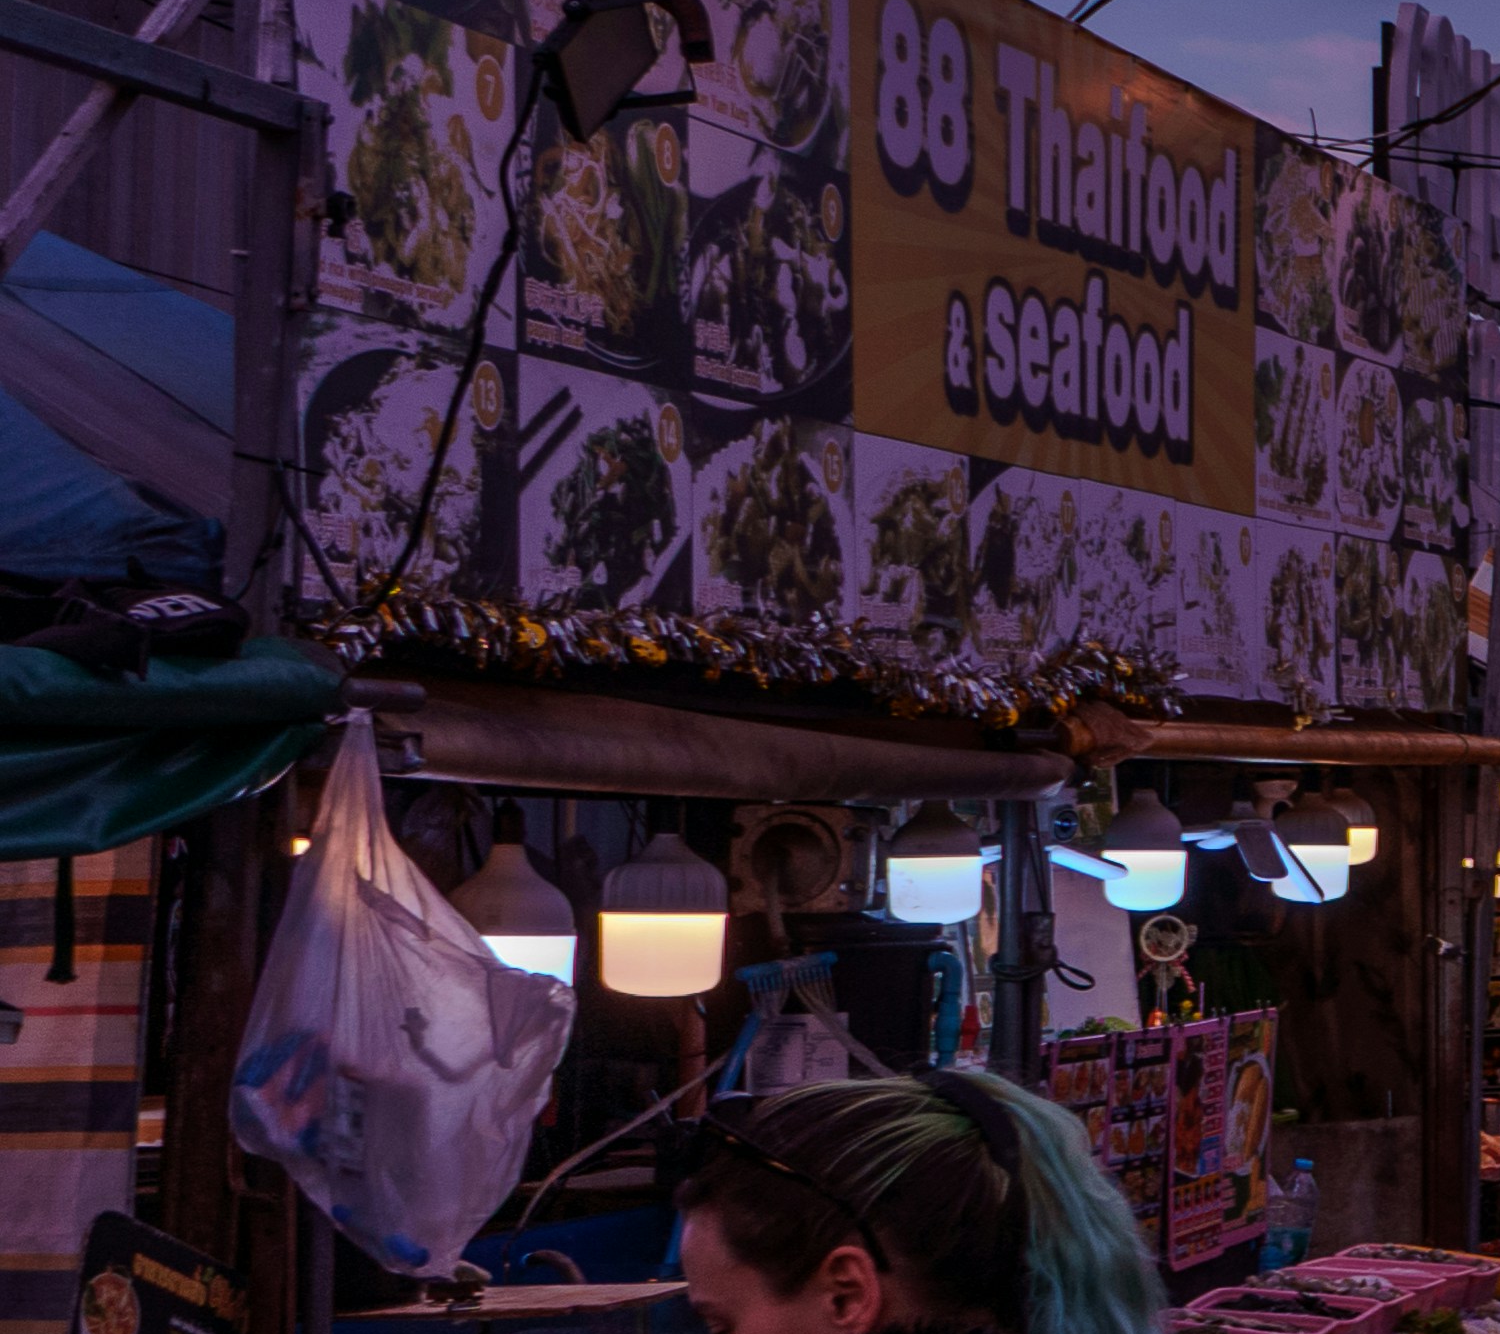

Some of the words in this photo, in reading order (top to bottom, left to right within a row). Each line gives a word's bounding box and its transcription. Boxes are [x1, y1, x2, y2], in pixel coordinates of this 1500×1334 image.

[483, 72, 496, 95] 7
[661, 143, 673, 166] 8
[997, 40, 1240, 307] Thaifood
[945, 295, 976, 407] &
[985, 272, 1193, 462] seafood
[477, 381, 498, 409] 13
[660, 418, 680, 445] 14
[825, 454, 843, 480] 15
